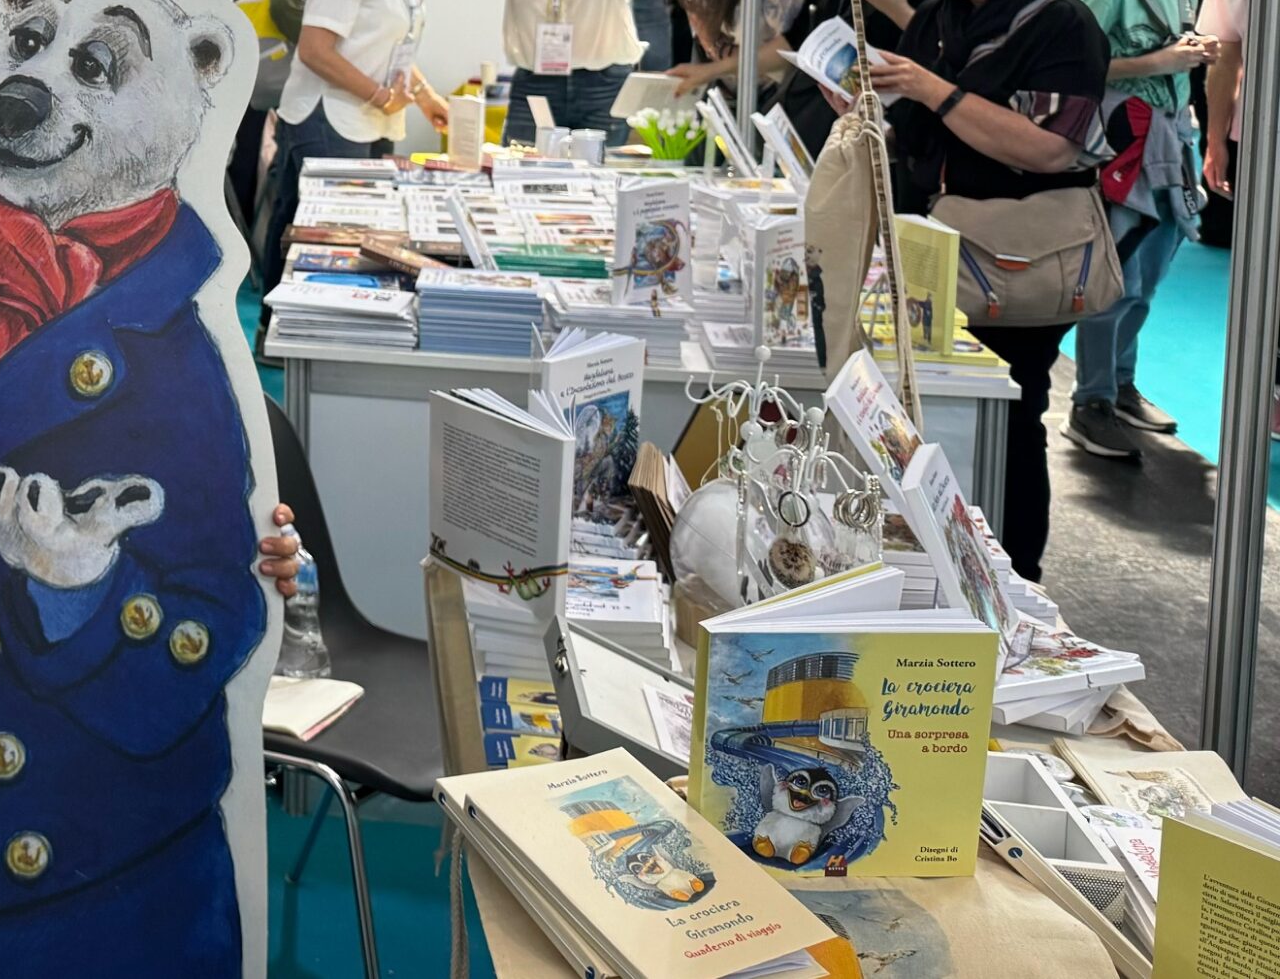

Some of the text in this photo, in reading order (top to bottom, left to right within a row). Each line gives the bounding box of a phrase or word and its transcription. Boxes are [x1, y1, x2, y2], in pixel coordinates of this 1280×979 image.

[896, 658, 976, 668] Marzia Sottero
[881, 678, 976, 696] La crociera
[882, 698, 974, 721] Giramondo
[888, 729, 969, 741] Una sorpresa
[932, 744, 968, 753] bordo
[547, 769, 608, 790] Marzia Sottero
[920, 846, 958, 854] Disegni di
[915, 855, 945, 863] Cristina
[666, 899, 741, 928] La crociera
[685, 913, 754, 940] Giramondo
[684, 923, 781, 959] Quaderno di viaggio
[1240, 946, 1255, 956] della
